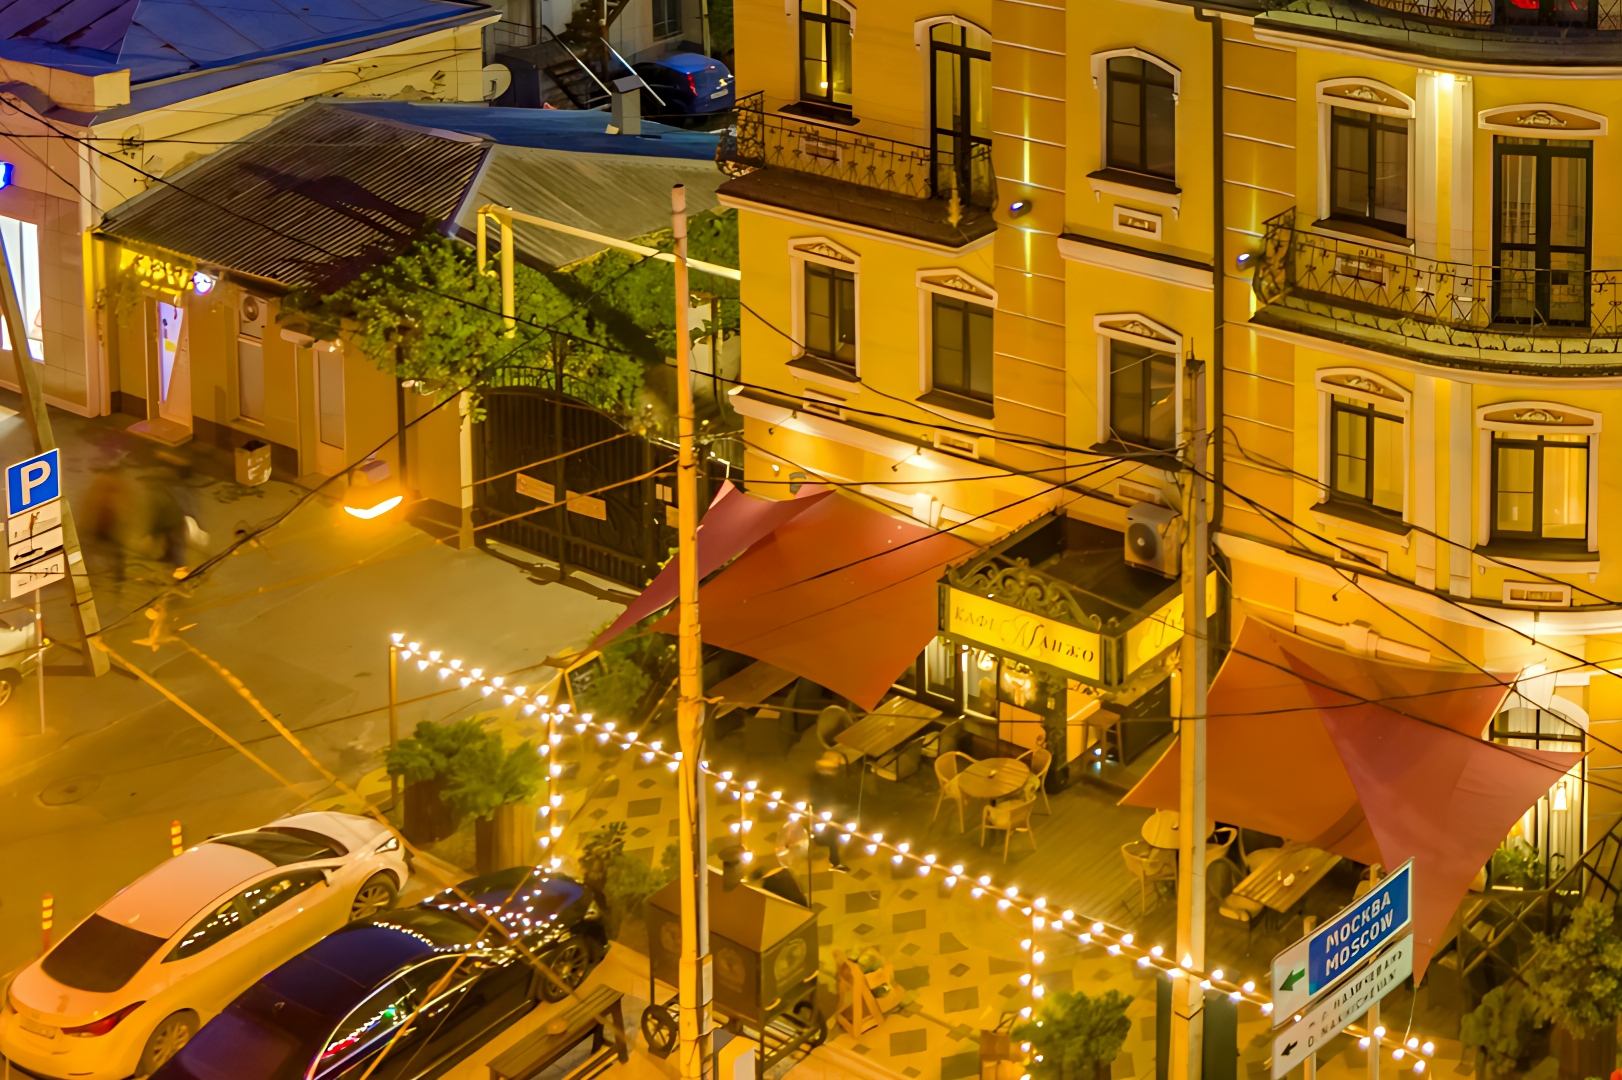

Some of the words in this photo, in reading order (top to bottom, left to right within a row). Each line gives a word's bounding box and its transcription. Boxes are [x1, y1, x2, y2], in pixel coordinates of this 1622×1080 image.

[20, 460, 51, 506] P
[1326, 891, 1391, 953] МОСКВА
[1326, 909, 1394, 977] MOSCOW
